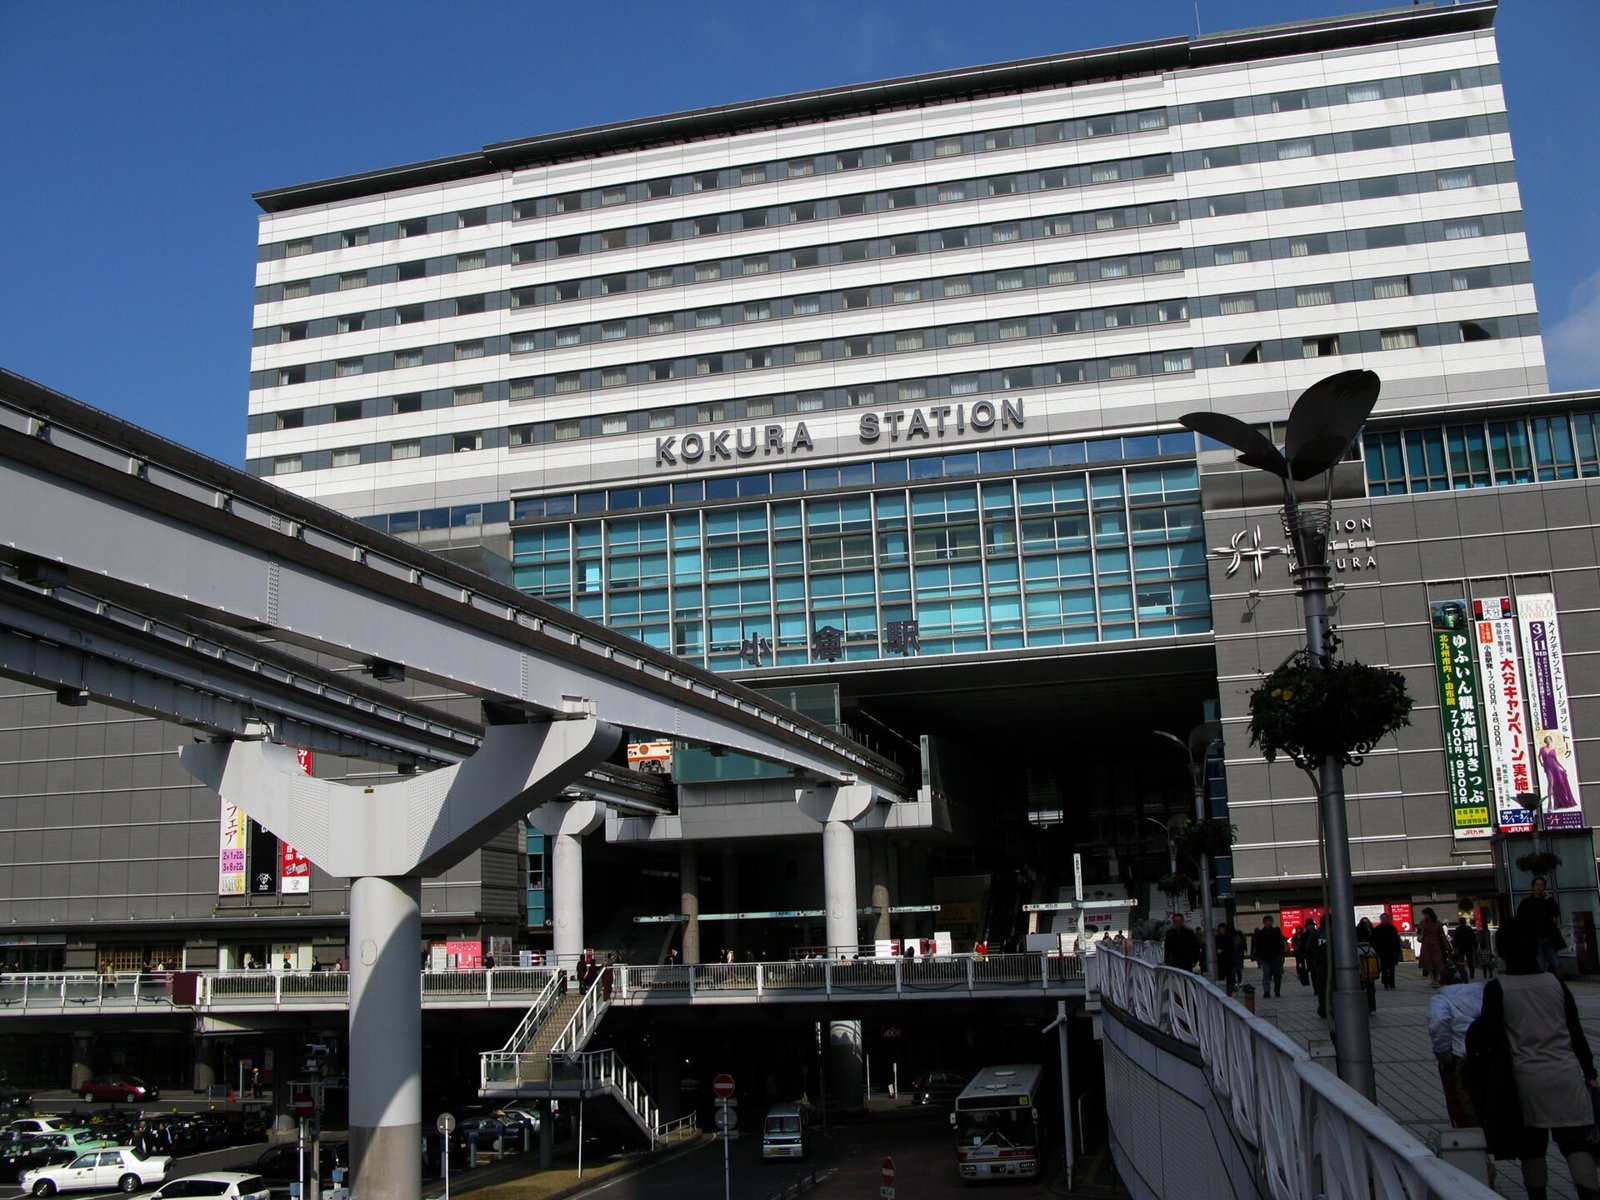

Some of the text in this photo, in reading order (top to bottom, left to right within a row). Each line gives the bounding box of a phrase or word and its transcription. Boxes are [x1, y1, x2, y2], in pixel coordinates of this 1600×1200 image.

[656, 397, 1026, 466] KOKURA STATION
[1287, 537, 1376, 555] HTEL
[1289, 556, 1377, 574] KURA
[739, 620, 921, 667] 小倉駅
[1452, 634, 1485, 804] ゆふいん観光割引きっぷ
[1500, 658, 1529, 794] 大分キャンペーン実施
[225, 805, 238, 846] フェア
[1462, 829, 1485, 837] JR九州
